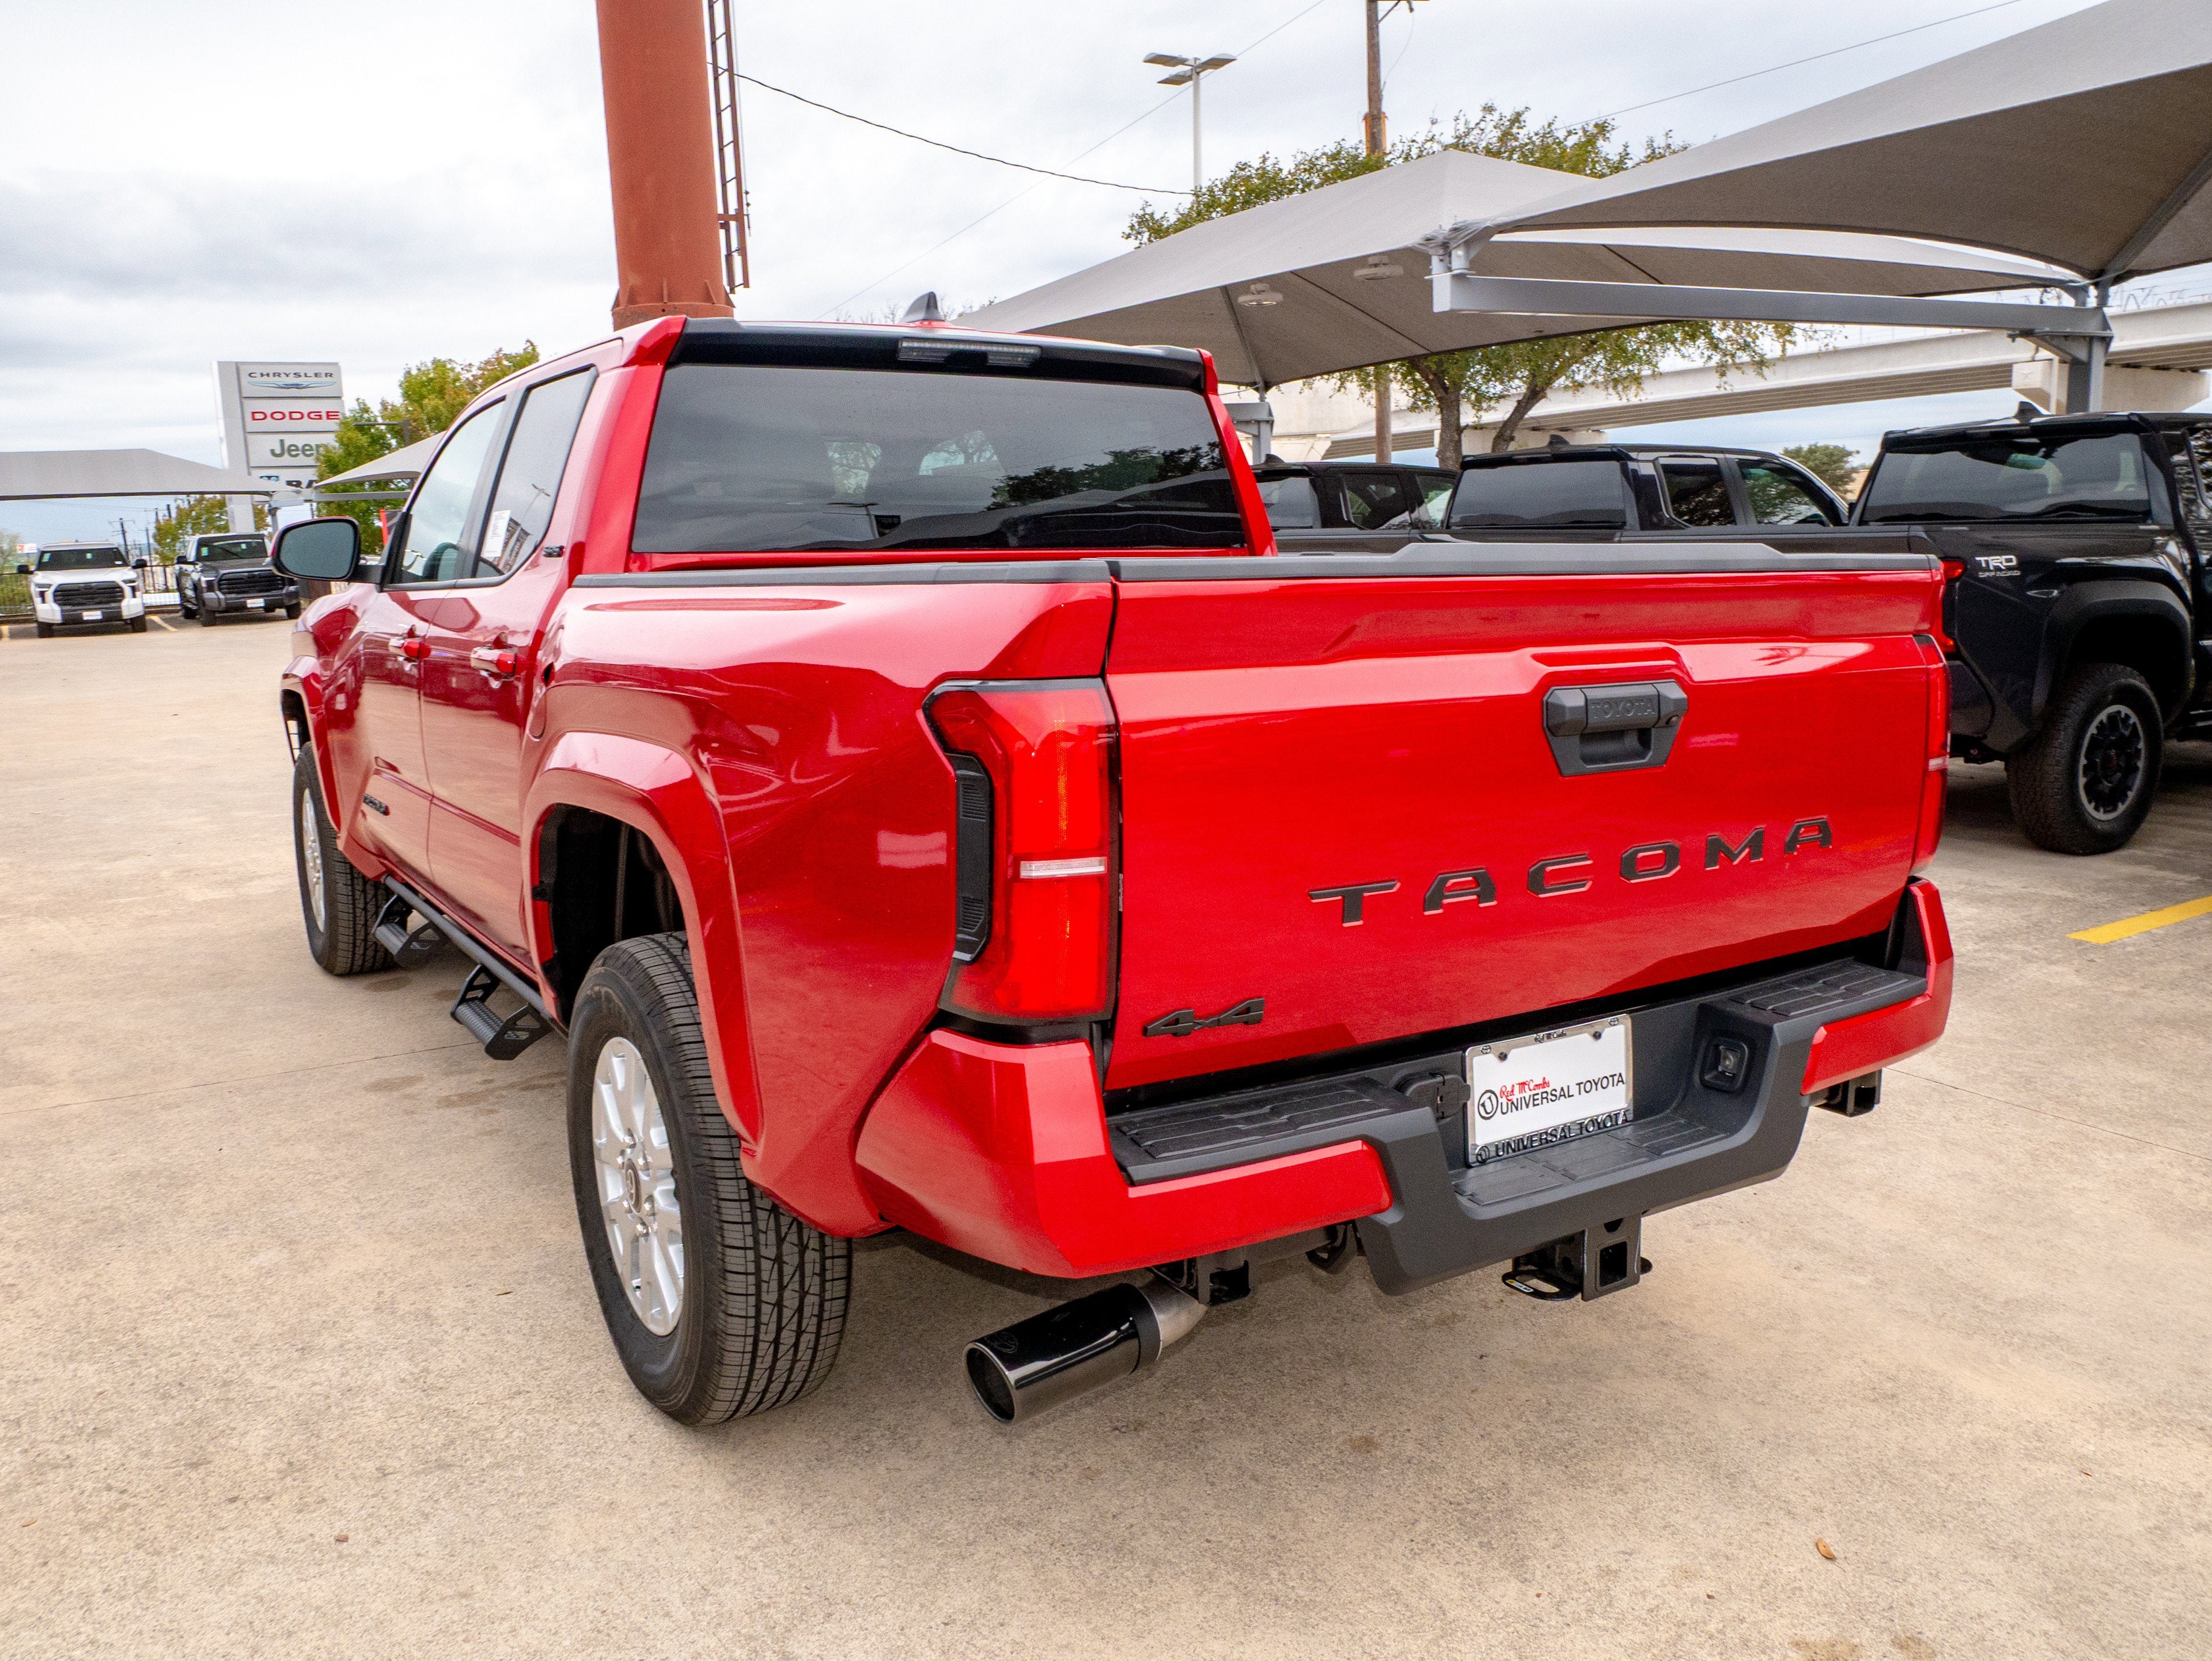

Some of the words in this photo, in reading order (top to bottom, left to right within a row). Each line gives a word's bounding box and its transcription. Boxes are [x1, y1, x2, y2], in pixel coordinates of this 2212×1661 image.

[251, 411, 340, 421] DODGE
[1975, 555, 2017, 570] TRD
[1590, 699, 1656, 718] TOYOTA
[1308, 816, 1832, 927] TACOMA
[1500, 1085, 1514, 1102] Red
[1501, 1085, 1574, 1115] UNIVERSAL
[1575, 1073, 1625, 1095] TOYOTA
[1495, 1124, 1575, 1156] UNIVERSAL
[1576, 1110, 1628, 1135] TOYOTA
